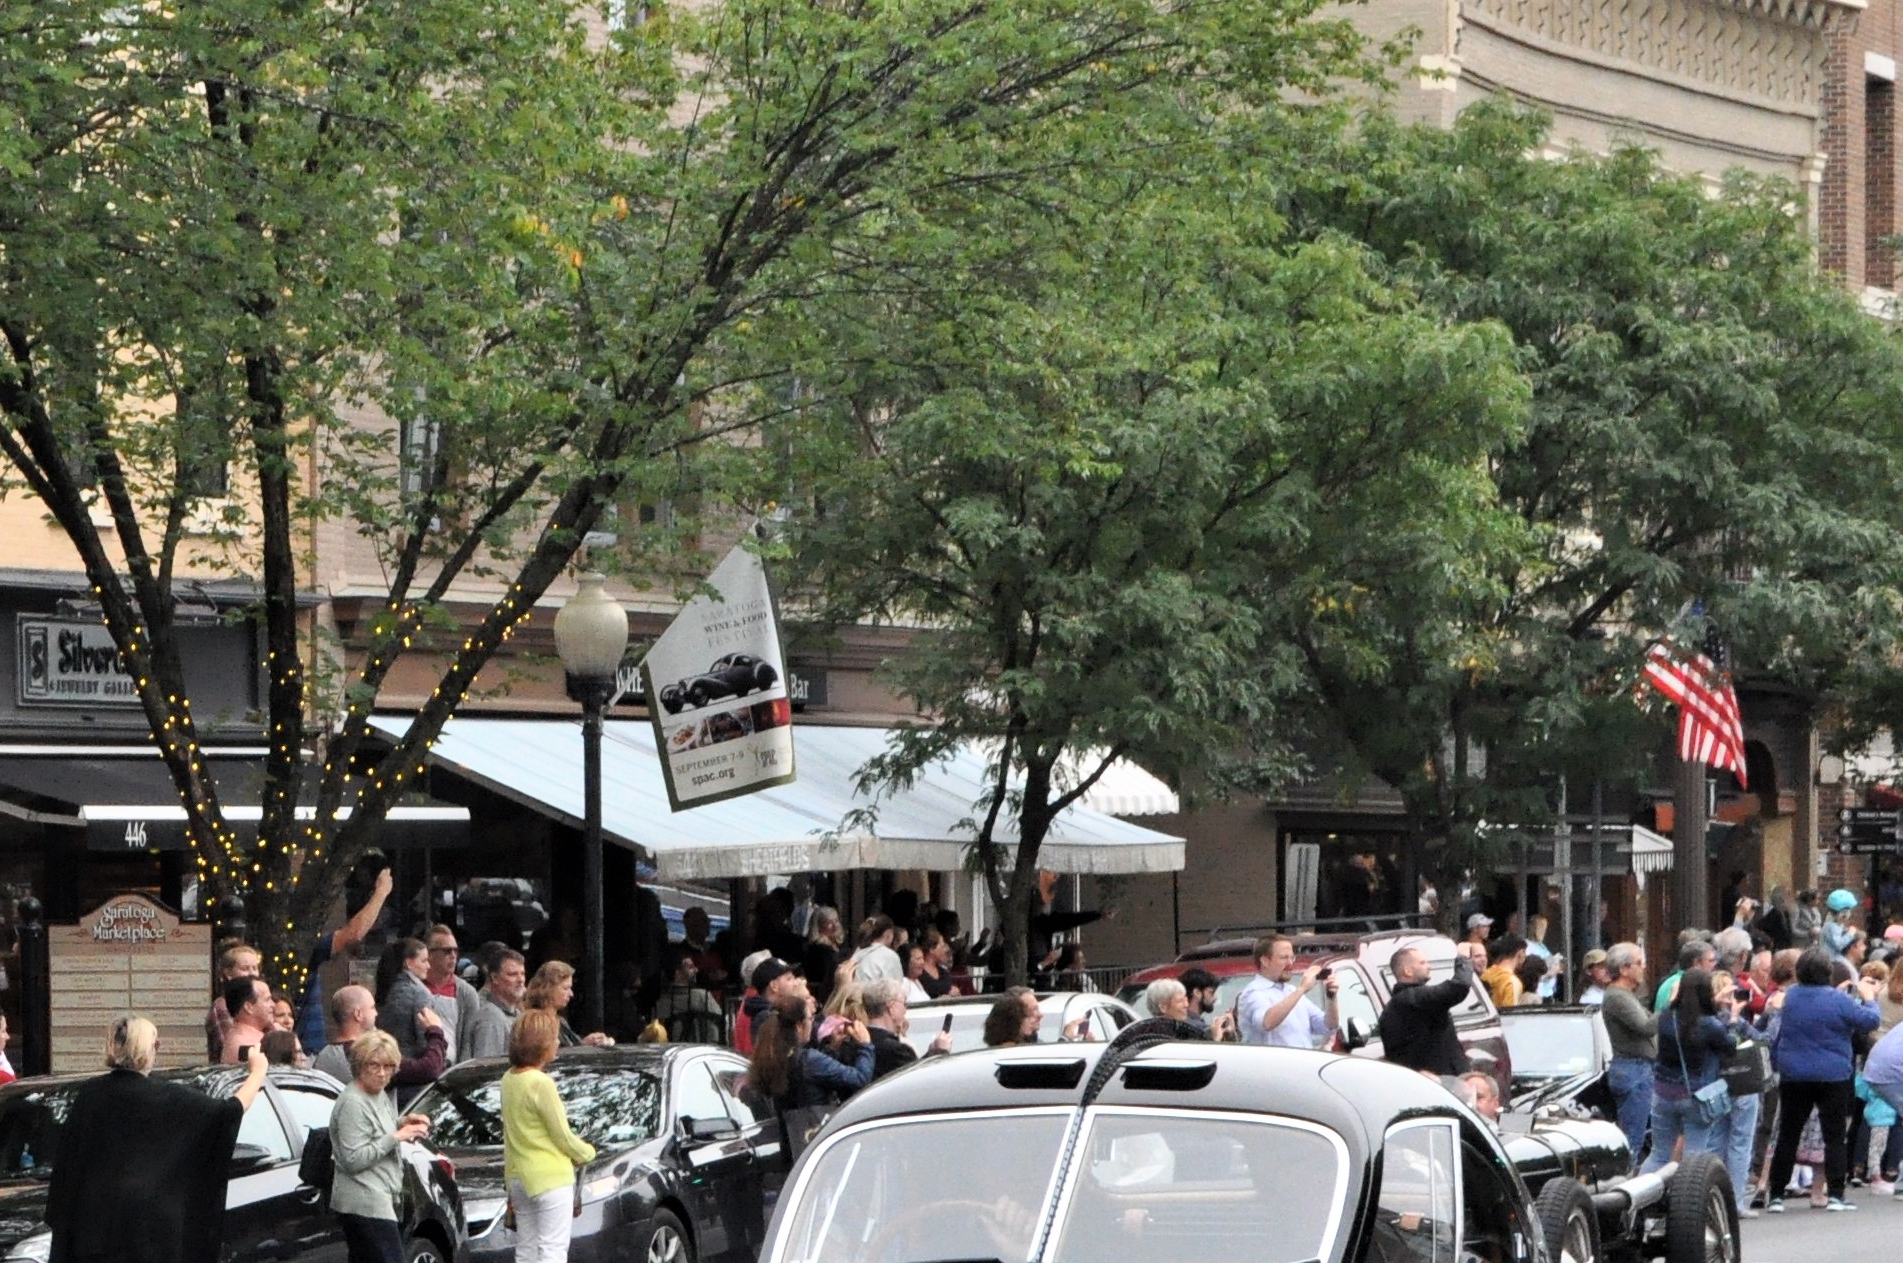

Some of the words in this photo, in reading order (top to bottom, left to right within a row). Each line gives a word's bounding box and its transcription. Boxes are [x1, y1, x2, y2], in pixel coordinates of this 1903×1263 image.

[704, 621, 731, 632] WINE
[742, 611, 767, 625] FOOD
[790, 673, 809, 700] Bar
[675, 753, 728, 774] SEPTEMBER
[731, 750, 745, 762] 7-9
[691, 767, 735, 786] spac.org
[125, 821, 147, 848] 446
[100, 905, 155, 928] Saratoga
[92, 925, 166, 944] Marketplace
